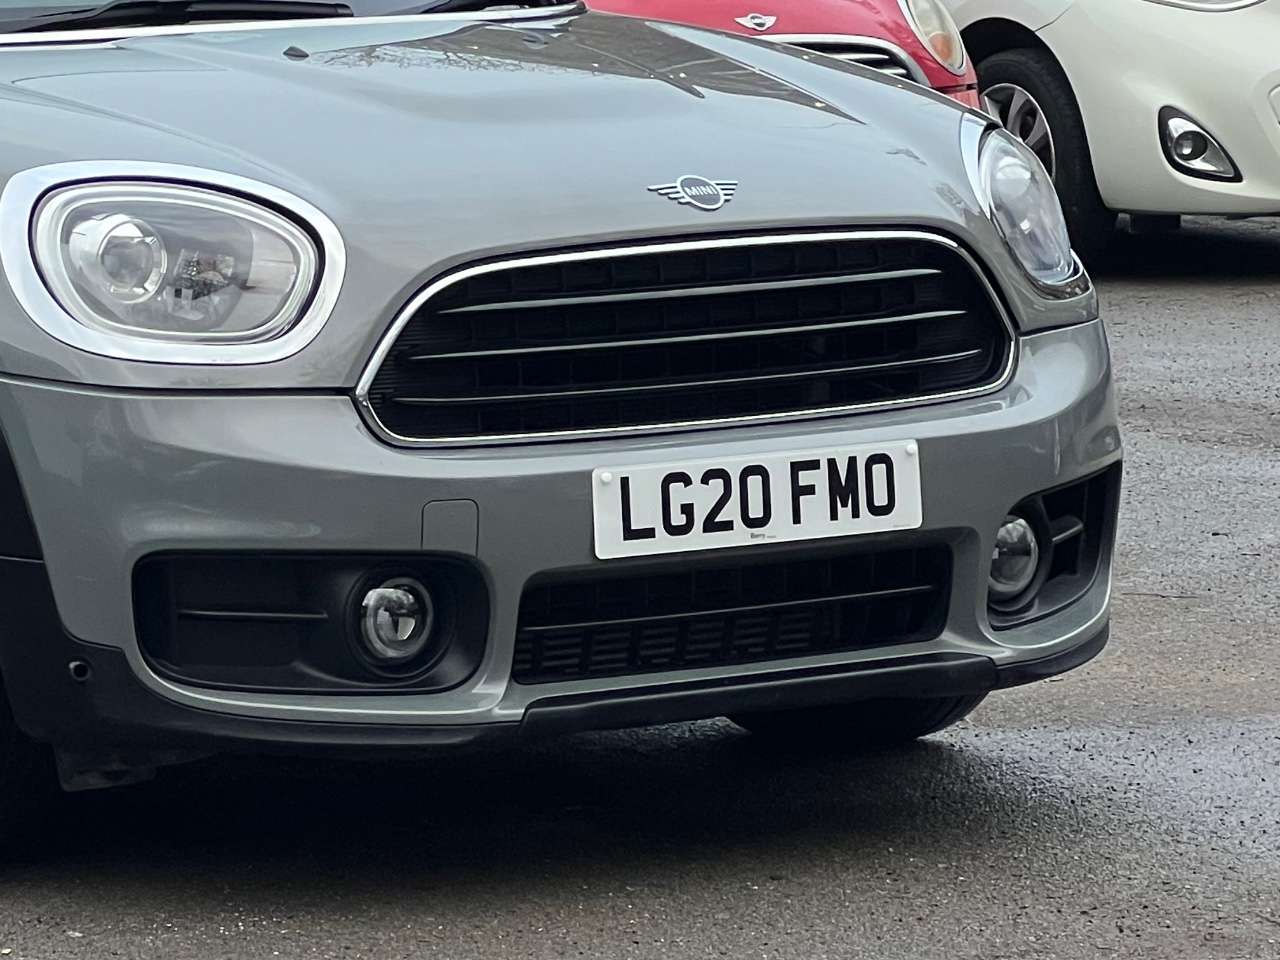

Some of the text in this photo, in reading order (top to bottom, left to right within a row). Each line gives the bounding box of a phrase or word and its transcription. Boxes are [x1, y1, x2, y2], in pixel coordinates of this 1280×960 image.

[684, 185, 718, 196] MINI
[620, 452, 896, 541] LG20 FMO
